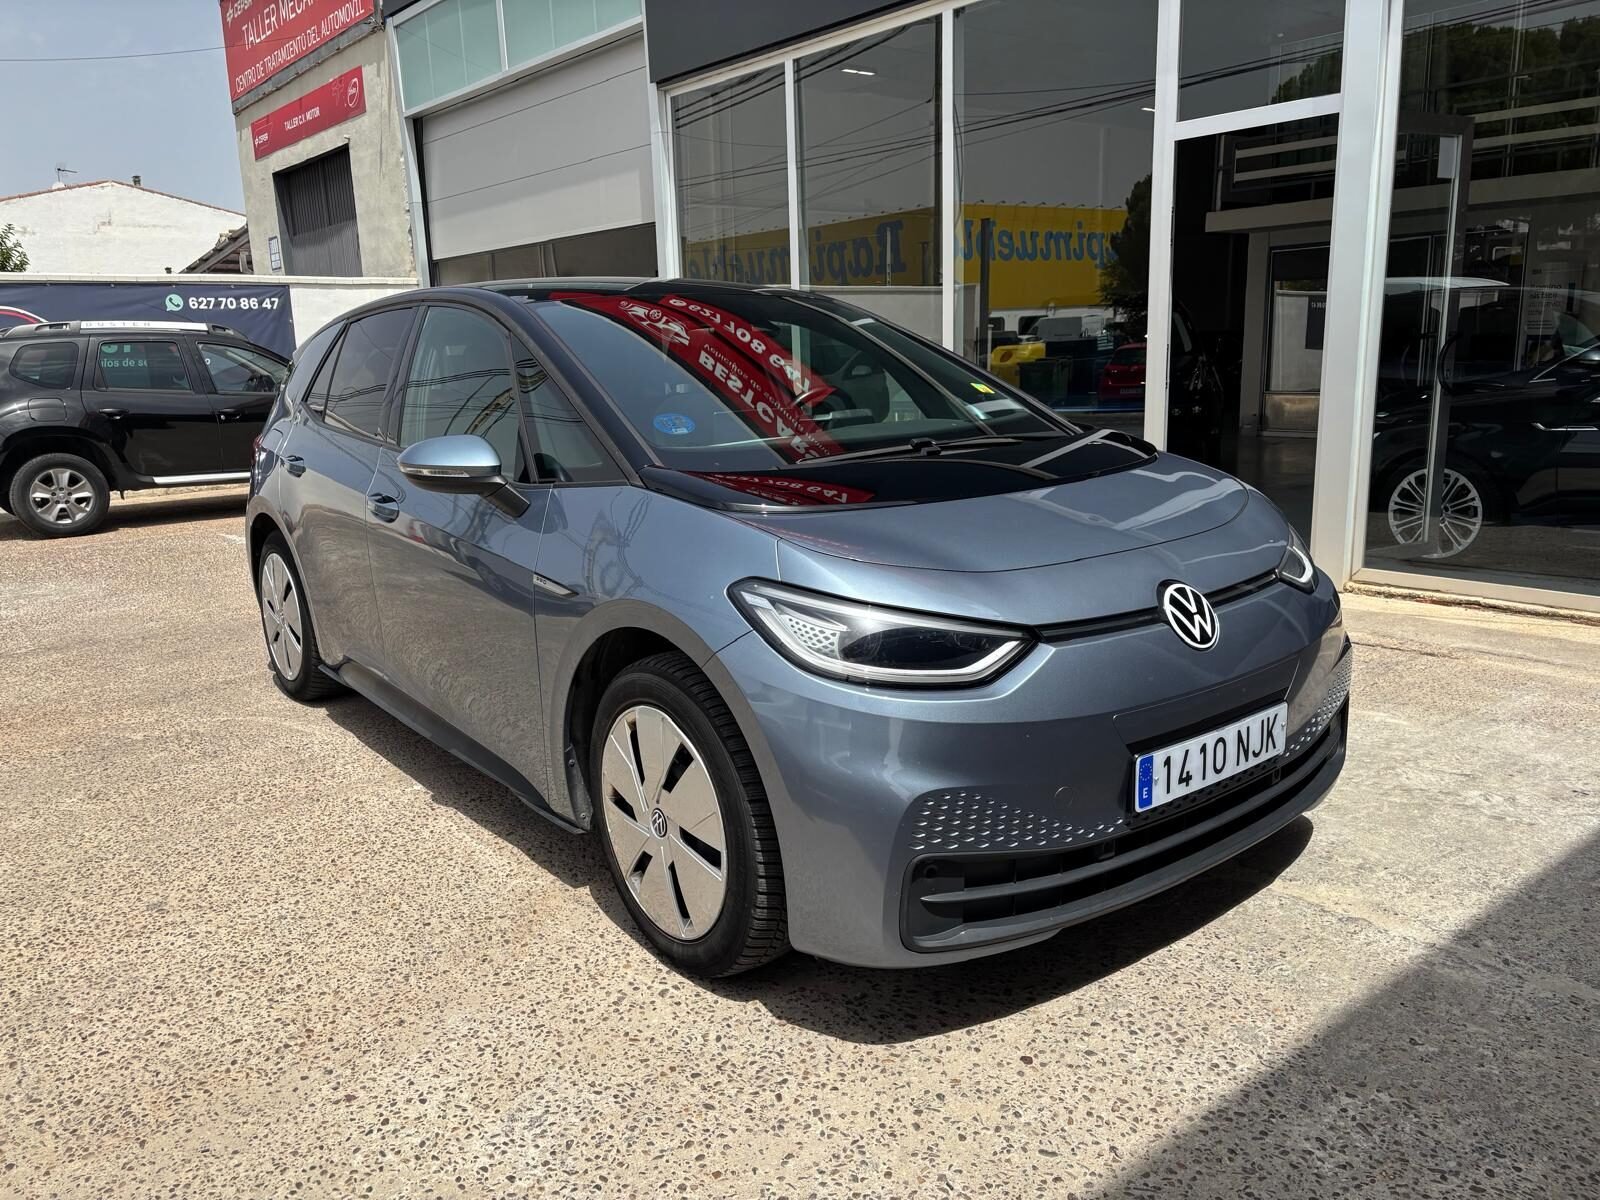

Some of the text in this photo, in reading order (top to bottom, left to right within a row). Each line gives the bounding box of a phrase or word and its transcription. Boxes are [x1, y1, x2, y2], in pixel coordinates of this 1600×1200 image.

[242, 0, 314, 51] TALLER MEC
[235, 66, 257, 93] CENTRO
[256, 60, 265, 81] DE
[264, 33, 306, 73] TRATAMIENTO
[307, 25, 321, 47] DEL
[284, 117, 299, 131] TALLER
[306, 106, 321, 122] MOTOR
[188, 297, 279, 310] 627 70 86 47
[122, 357, 136, 368] de
[1163, 713, 1279, 795] 1410 NJK
[1142, 787, 1149, 800] E
